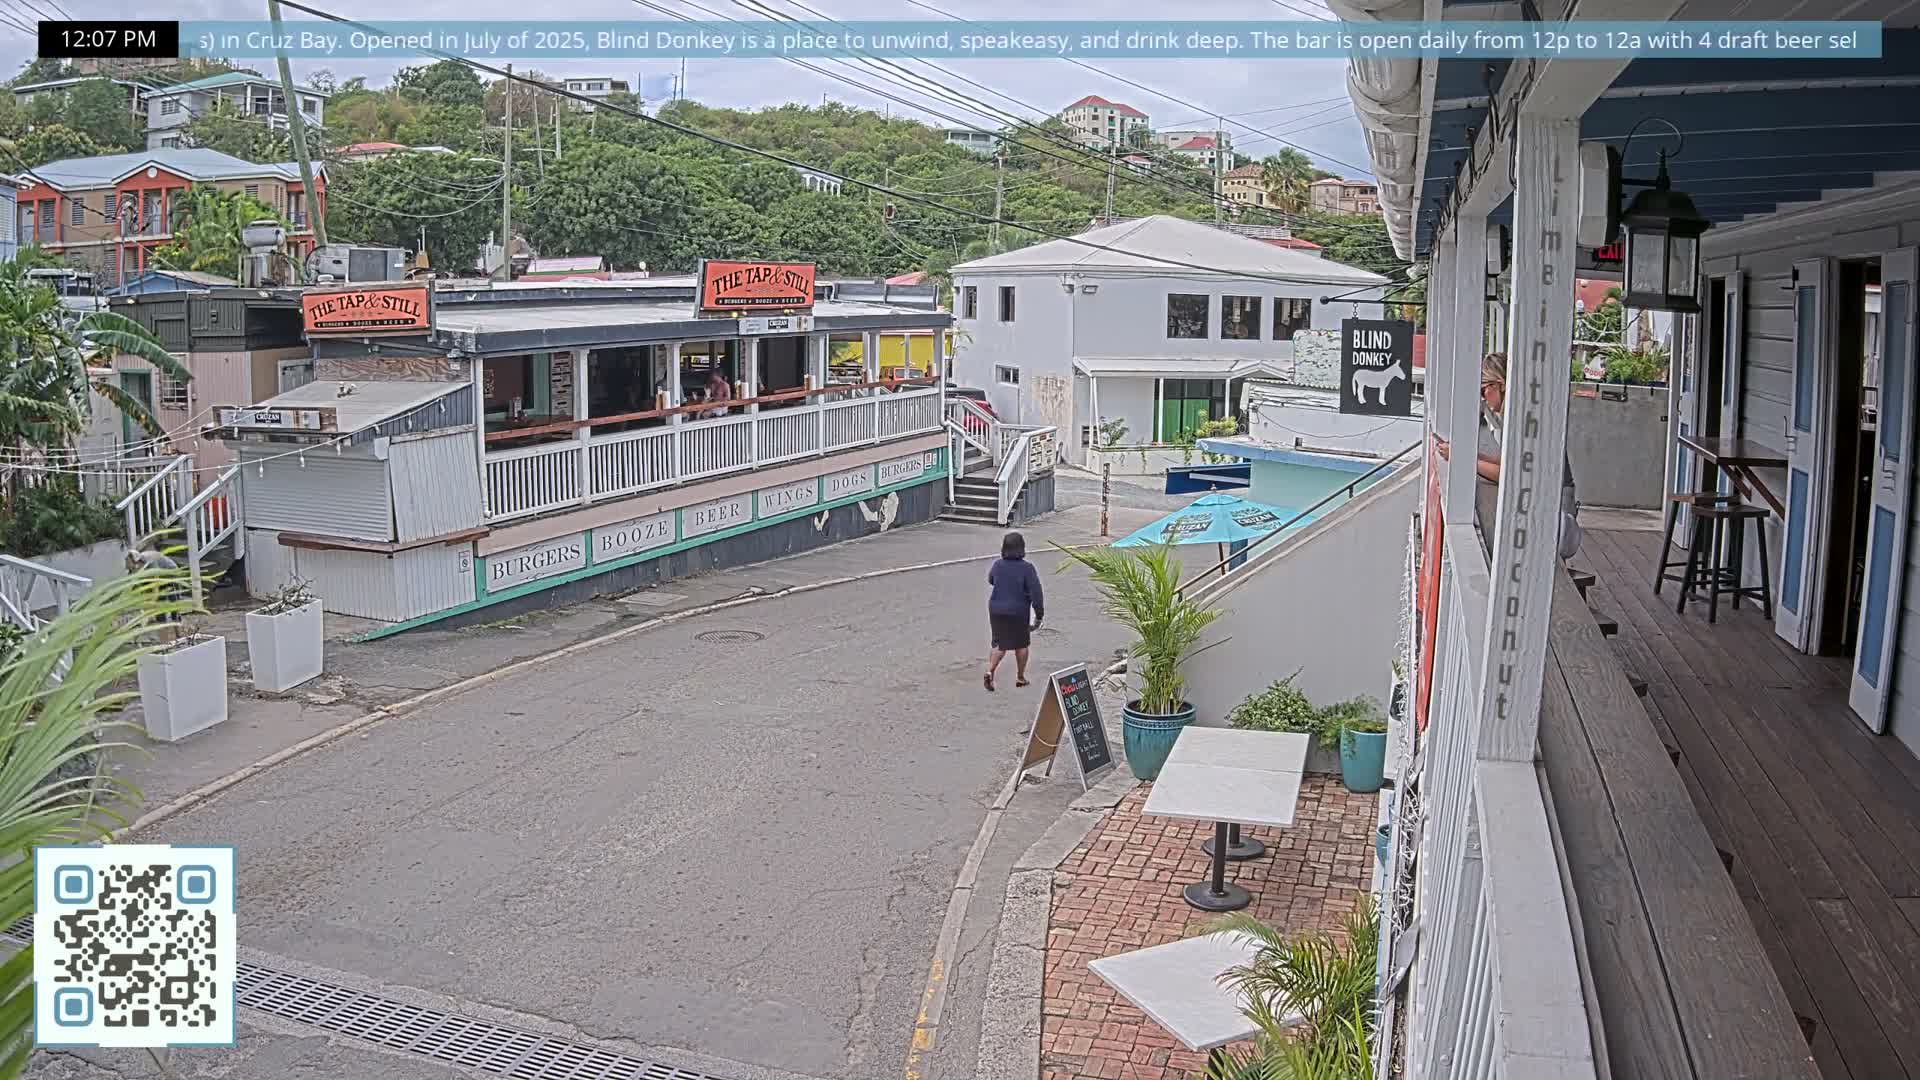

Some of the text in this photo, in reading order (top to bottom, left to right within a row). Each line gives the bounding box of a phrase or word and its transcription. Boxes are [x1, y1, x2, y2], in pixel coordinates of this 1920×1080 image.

[712, 270, 743, 296] THE
[745, 267, 771, 285] TAP
[784, 270, 809, 296] STILL
[309, 299, 337, 321] THE
[336, 294, 365, 311] TAP
[382, 295, 421, 318] STILL
[1353, 329, 1392, 350] BLIND
[1352, 351, 1393, 367] DONKEY
[881, 459, 922, 479] BURGERS
[832, 471, 867, 492] DOGS
[764, 485, 814, 509] WINGS
[695, 502, 740, 526] BEER
[601, 520, 668, 551] BOOZE
[492, 543, 580, 580] BURGERS
